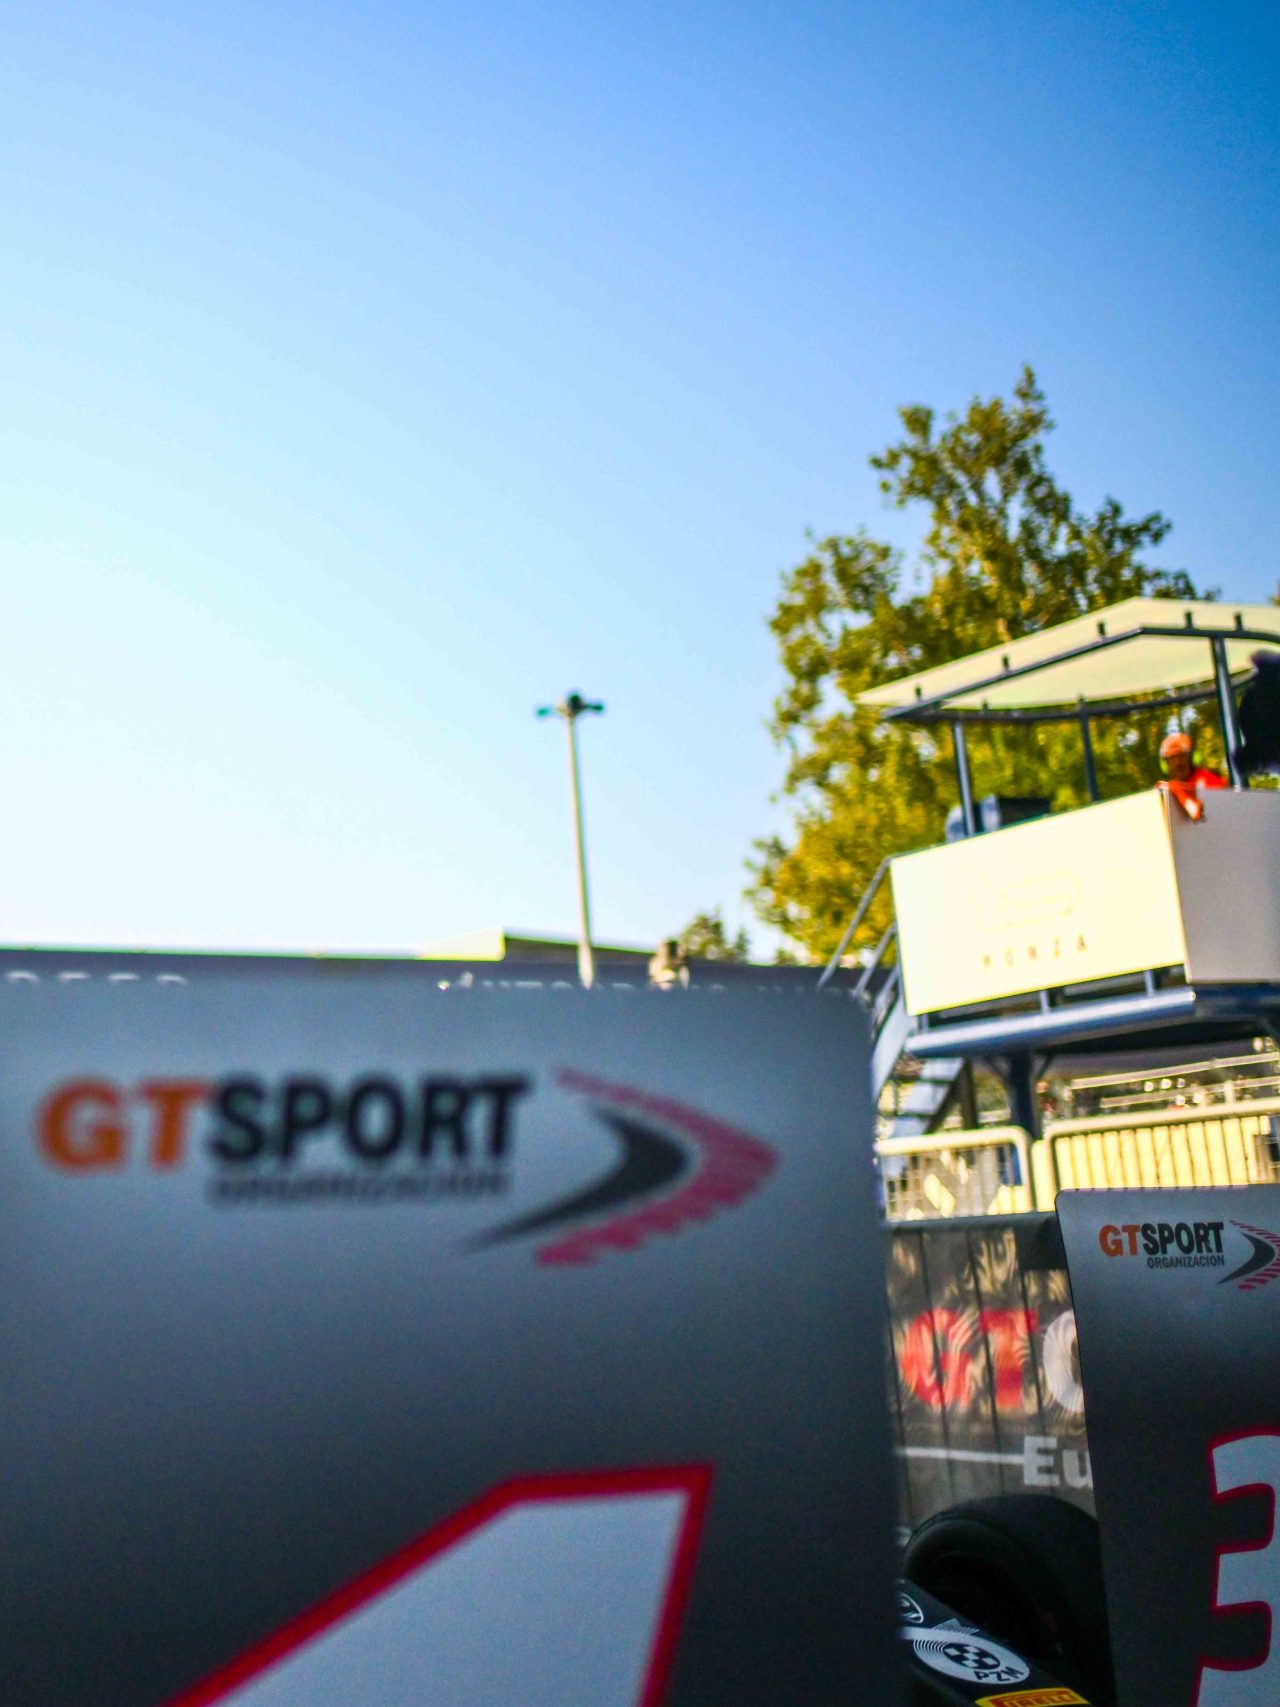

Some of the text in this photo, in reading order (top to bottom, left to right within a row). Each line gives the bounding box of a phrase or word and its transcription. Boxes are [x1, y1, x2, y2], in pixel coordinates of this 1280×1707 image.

[39, 1070, 532, 1175] GTSPORT
[1099, 1221, 1224, 1257] GTSPORT
[1147, 1255, 1225, 1269] ORGANIZACION
